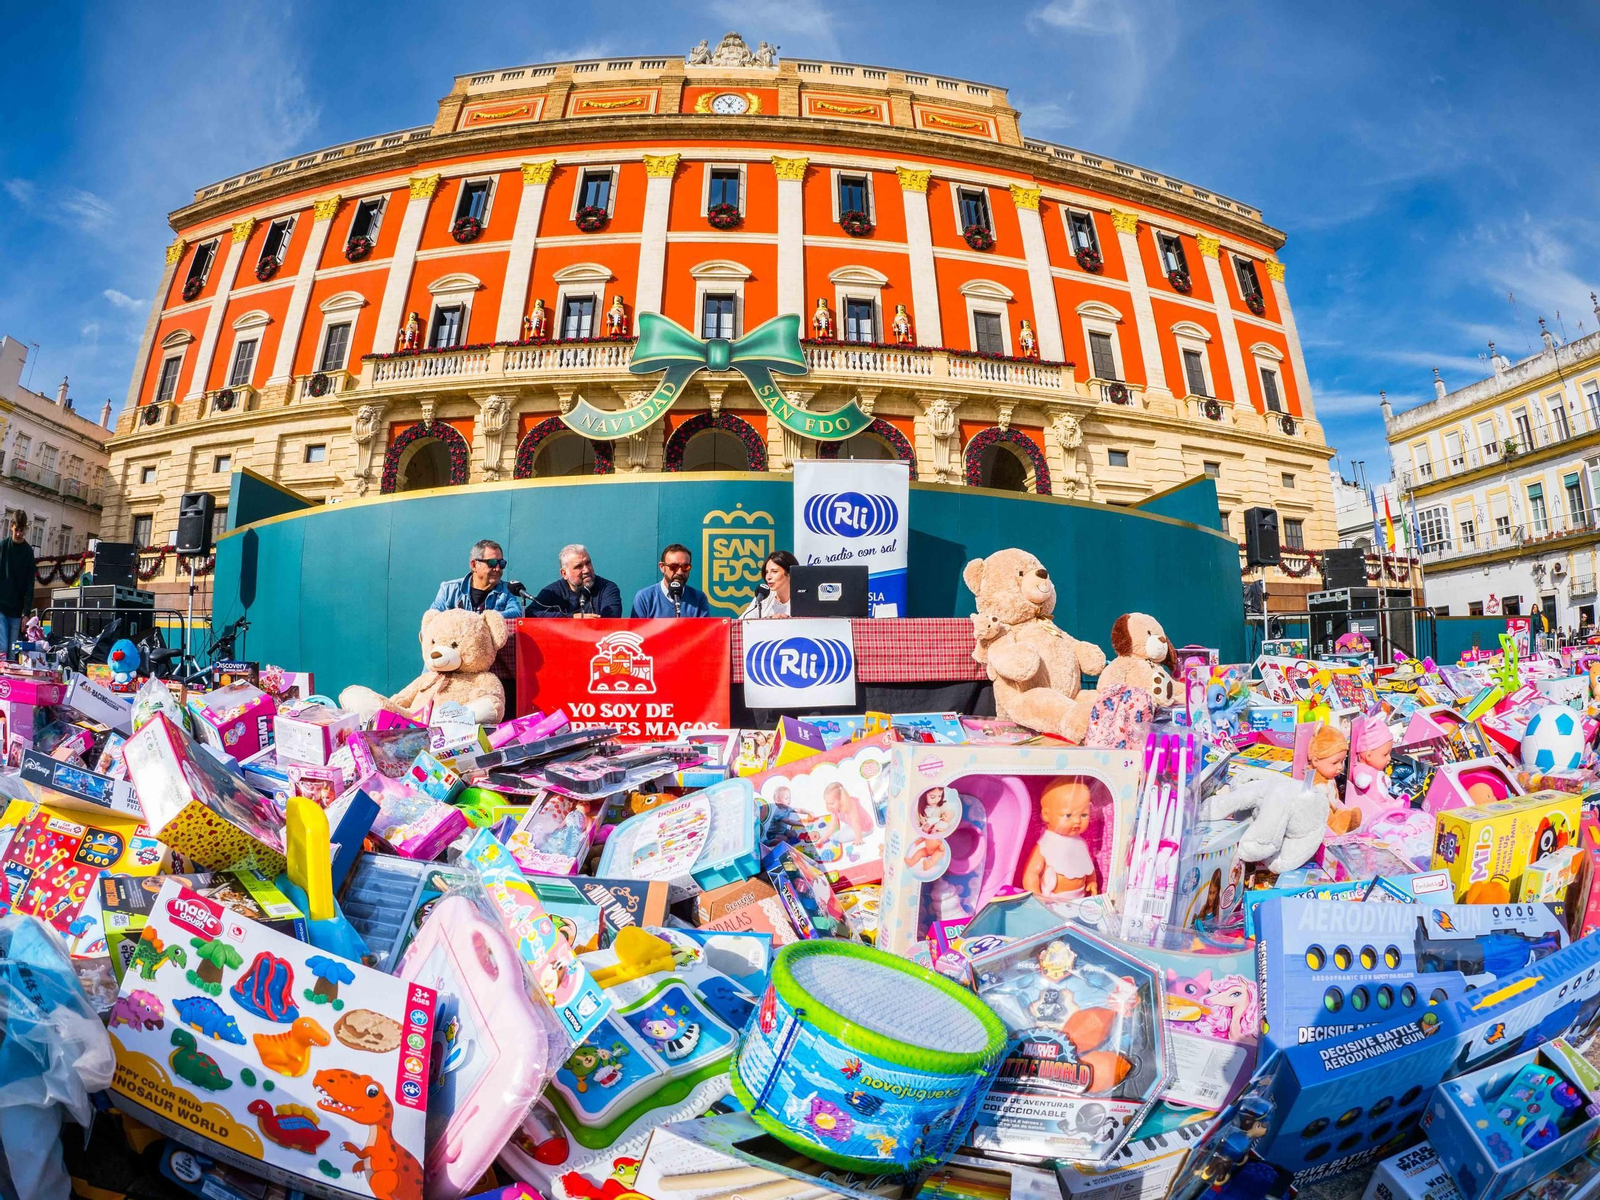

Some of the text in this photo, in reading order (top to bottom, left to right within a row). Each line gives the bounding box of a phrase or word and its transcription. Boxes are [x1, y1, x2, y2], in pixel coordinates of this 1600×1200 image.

[581, 382, 675, 433] NAVIDAD
[758, 384, 850, 434] SAN FDO
[713, 538, 764, 557] SAN
[807, 539, 896, 566] La radio con sal
[215, 661, 247, 670] Discovery
[567, 703, 674, 718] YO SOY DE
[24, 757, 50, 776] Disney
[657, 801, 692, 818] beauty
[1472, 826, 1492, 881] Milo
[1505, 840, 1516, 874] Talking
[174, 899, 218, 929] magic
[179, 910, 205, 930] dough
[1453, 906, 1482, 931] GUN
[412, 996, 430, 1006] AGES
[415, 988, 429, 999] 3+
[1022, 1043, 1060, 1058] MARVEL
[1319, 1035, 1377, 1060] DECISIVE
[1377, 1022, 1420, 1042] BATTLE
[1324, 1030, 1426, 1071] AERODYNAMIC GUN
[1001, 1058, 1038, 1077] TTLE
[1038, 1060, 1092, 1086] WORLD
[141, 1077, 176, 1100] COLOR
[178, 1096, 203, 1113] MUD
[1010, 1097, 1021, 1105] DE
[1023, 1099, 1075, 1109] AVENTURAS
[983, 1104, 1067, 1118] COLECCIONABLE
[177, 1106, 229, 1138] WORLD
[1329, 1145, 1381, 1166] BATTLE
[1348, 1156, 1374, 1170] GUN
[1396, 1151, 1435, 1171] WARS
[1397, 1146, 1434, 1165] STAR
